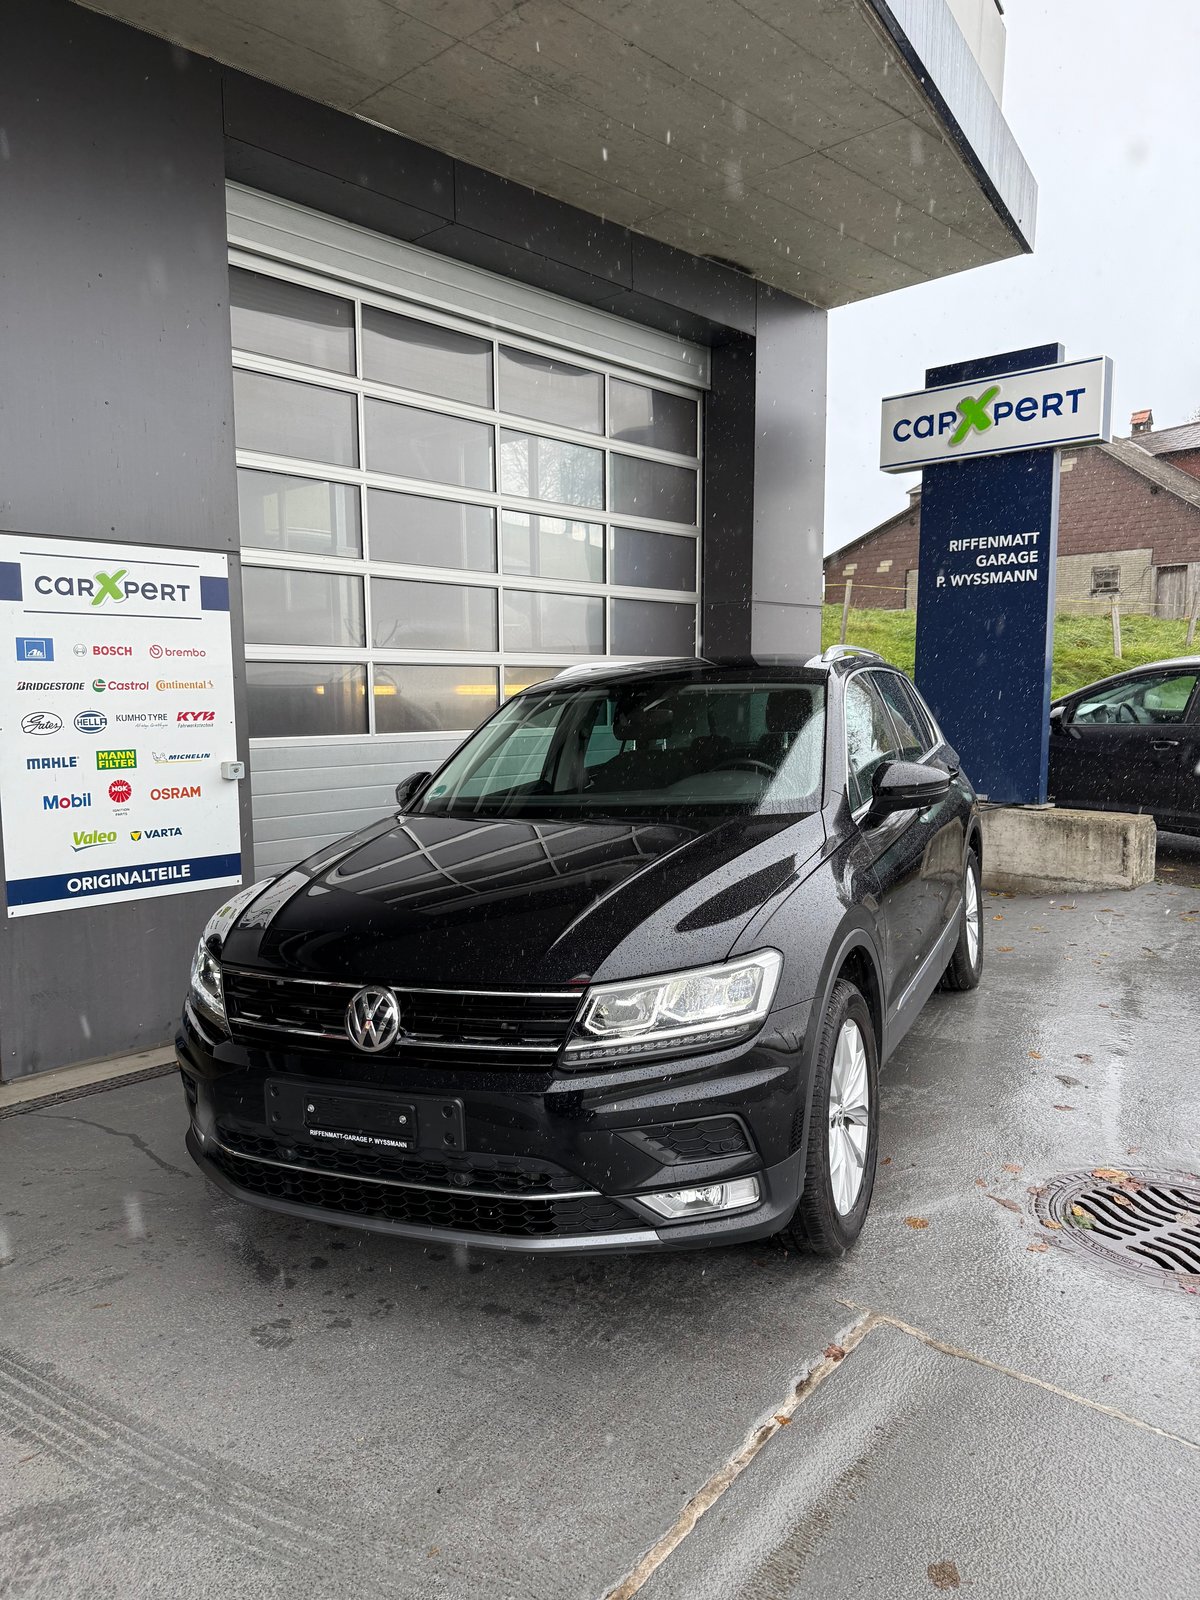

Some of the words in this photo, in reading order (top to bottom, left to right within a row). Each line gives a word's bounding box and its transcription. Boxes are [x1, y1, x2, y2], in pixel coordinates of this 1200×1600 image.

[949, 532, 1040, 552] RIFFENMATT
[976, 550, 1039, 567] GARAGE
[936, 575, 947, 588] P.
[950, 569, 1038, 587] WYSSMANN
[92, 645, 133, 656] BOSCH
[165, 647, 206, 658] brembo
[16, 681, 85, 691] BRIDGESTONE
[108, 681, 149, 691] Castrol
[155, 679, 207, 692] Continental
[76, 717, 108, 726] HELLA
[115, 713, 147, 722] KUMHO
[148, 713, 168, 721] TYRE
[176, 711, 216, 722] KYB
[23, 714, 60, 734] Gates
[98, 751, 135, 761] MANN
[26, 756, 77, 770] MAHLE
[98, 759, 136, 769] FILTER
[111, 785, 128, 793] NGK
[150, 786, 201, 801] OSRAM
[43, 793, 92, 810] Mobil
[73, 830, 117, 846] Valeo
[144, 828, 182, 839] VARTA
[66, 864, 191, 893] ORIGINALTEILE
[309, 1129, 368, 1143] RIFFENMATT-GARAGE
[374, 1138, 408, 1149] WYSSMANN
